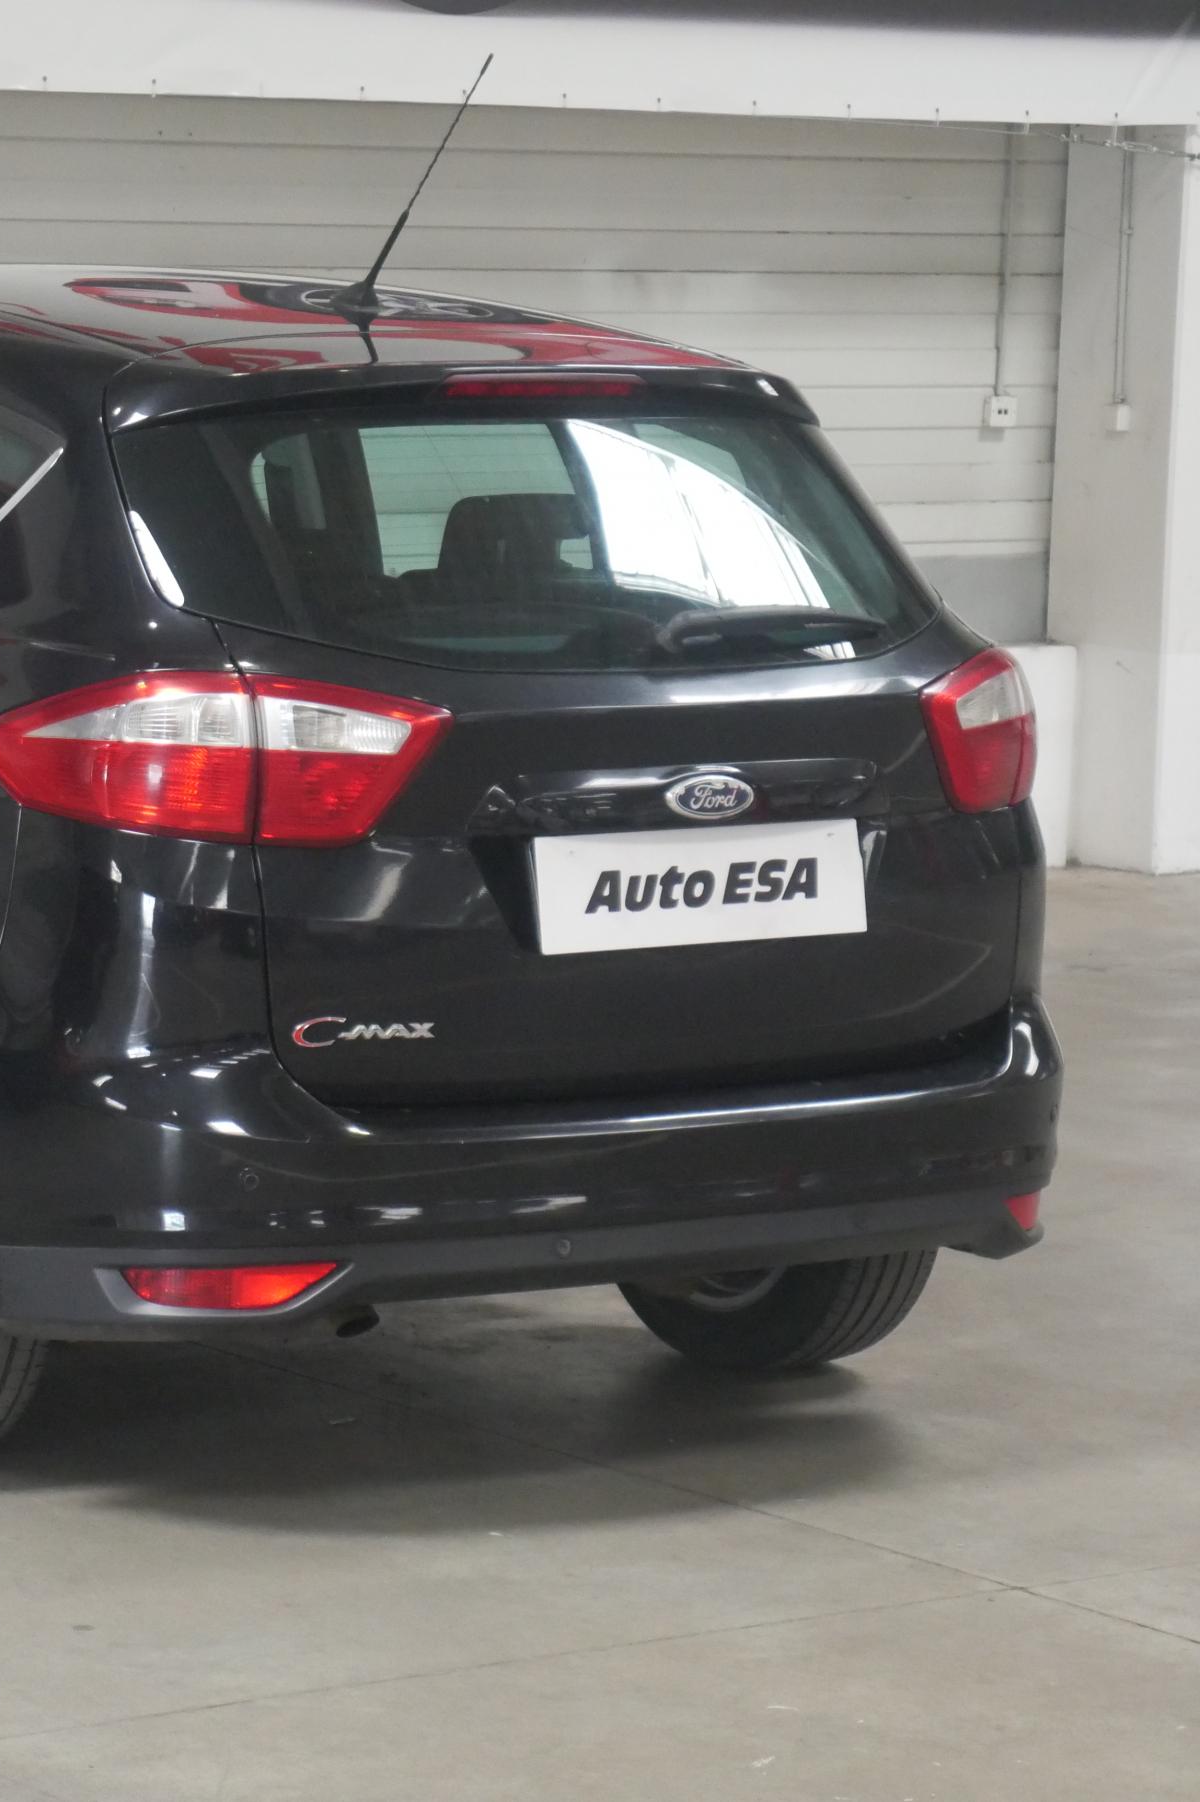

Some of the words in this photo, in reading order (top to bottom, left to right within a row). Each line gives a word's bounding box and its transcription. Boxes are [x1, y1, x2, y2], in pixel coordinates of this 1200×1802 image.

[690, 784, 737, 810] Ford
[585, 865, 715, 914] Auto
[722, 857, 818, 904] ESA
